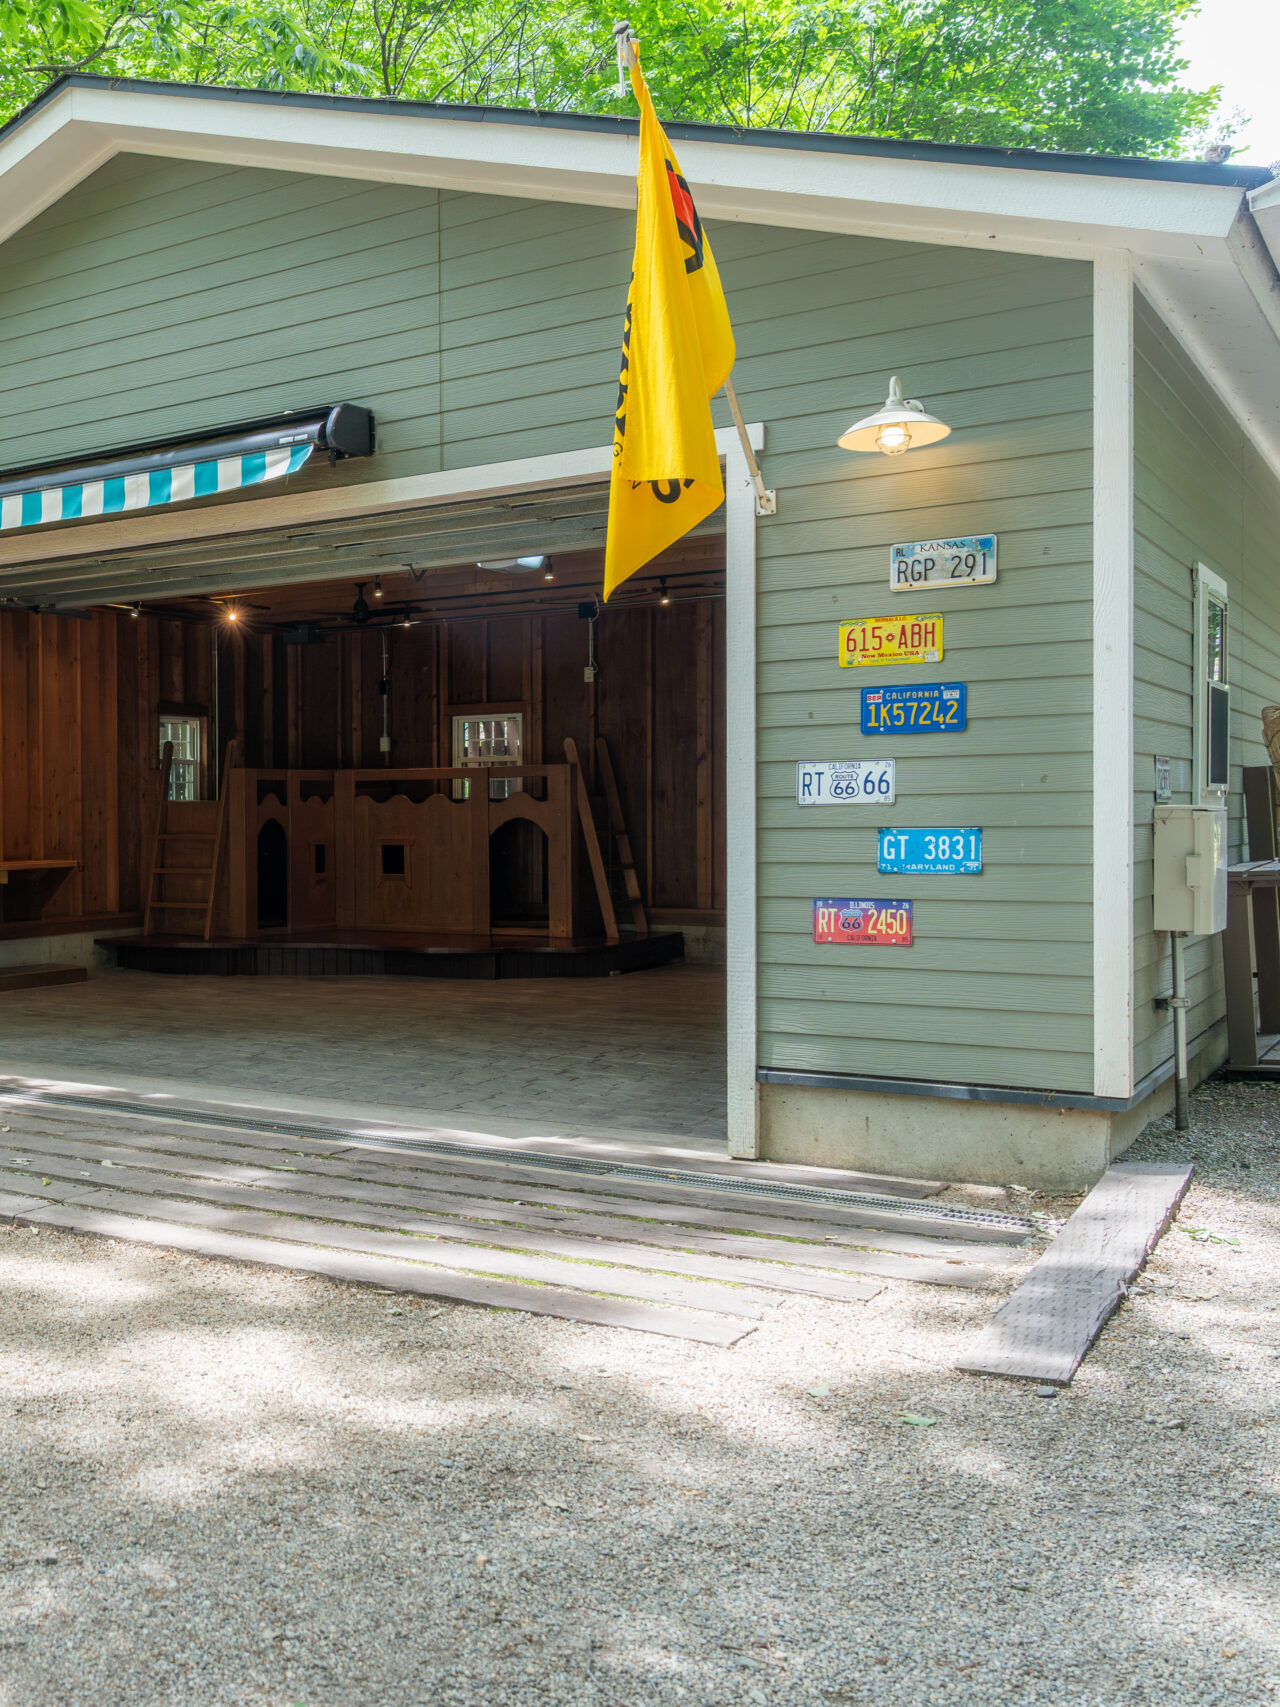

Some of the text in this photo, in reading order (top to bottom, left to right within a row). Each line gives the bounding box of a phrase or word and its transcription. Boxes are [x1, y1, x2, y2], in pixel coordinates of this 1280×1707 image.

[920, 541, 966, 552] KANSAS
[897, 552, 987, 583] RGP 291
[846, 622, 936, 652] 615 ABH
[886, 690, 939, 700] CALIFORNIA
[867, 700, 958, 727] 1K57242
[828, 762, 861, 770] CALIFORNIA
[802, 770, 890, 796] RT 66
[833, 781, 855, 795] 66
[883, 835, 976, 860] GT 3831
[902, 863, 955, 871] MARYLAND
[849, 901, 875, 909] ILLINOIS
[818, 908, 907, 934] RT 2450
[842, 917, 861, 929] 66
[847, 934, 877, 942] CALIFORNIA
